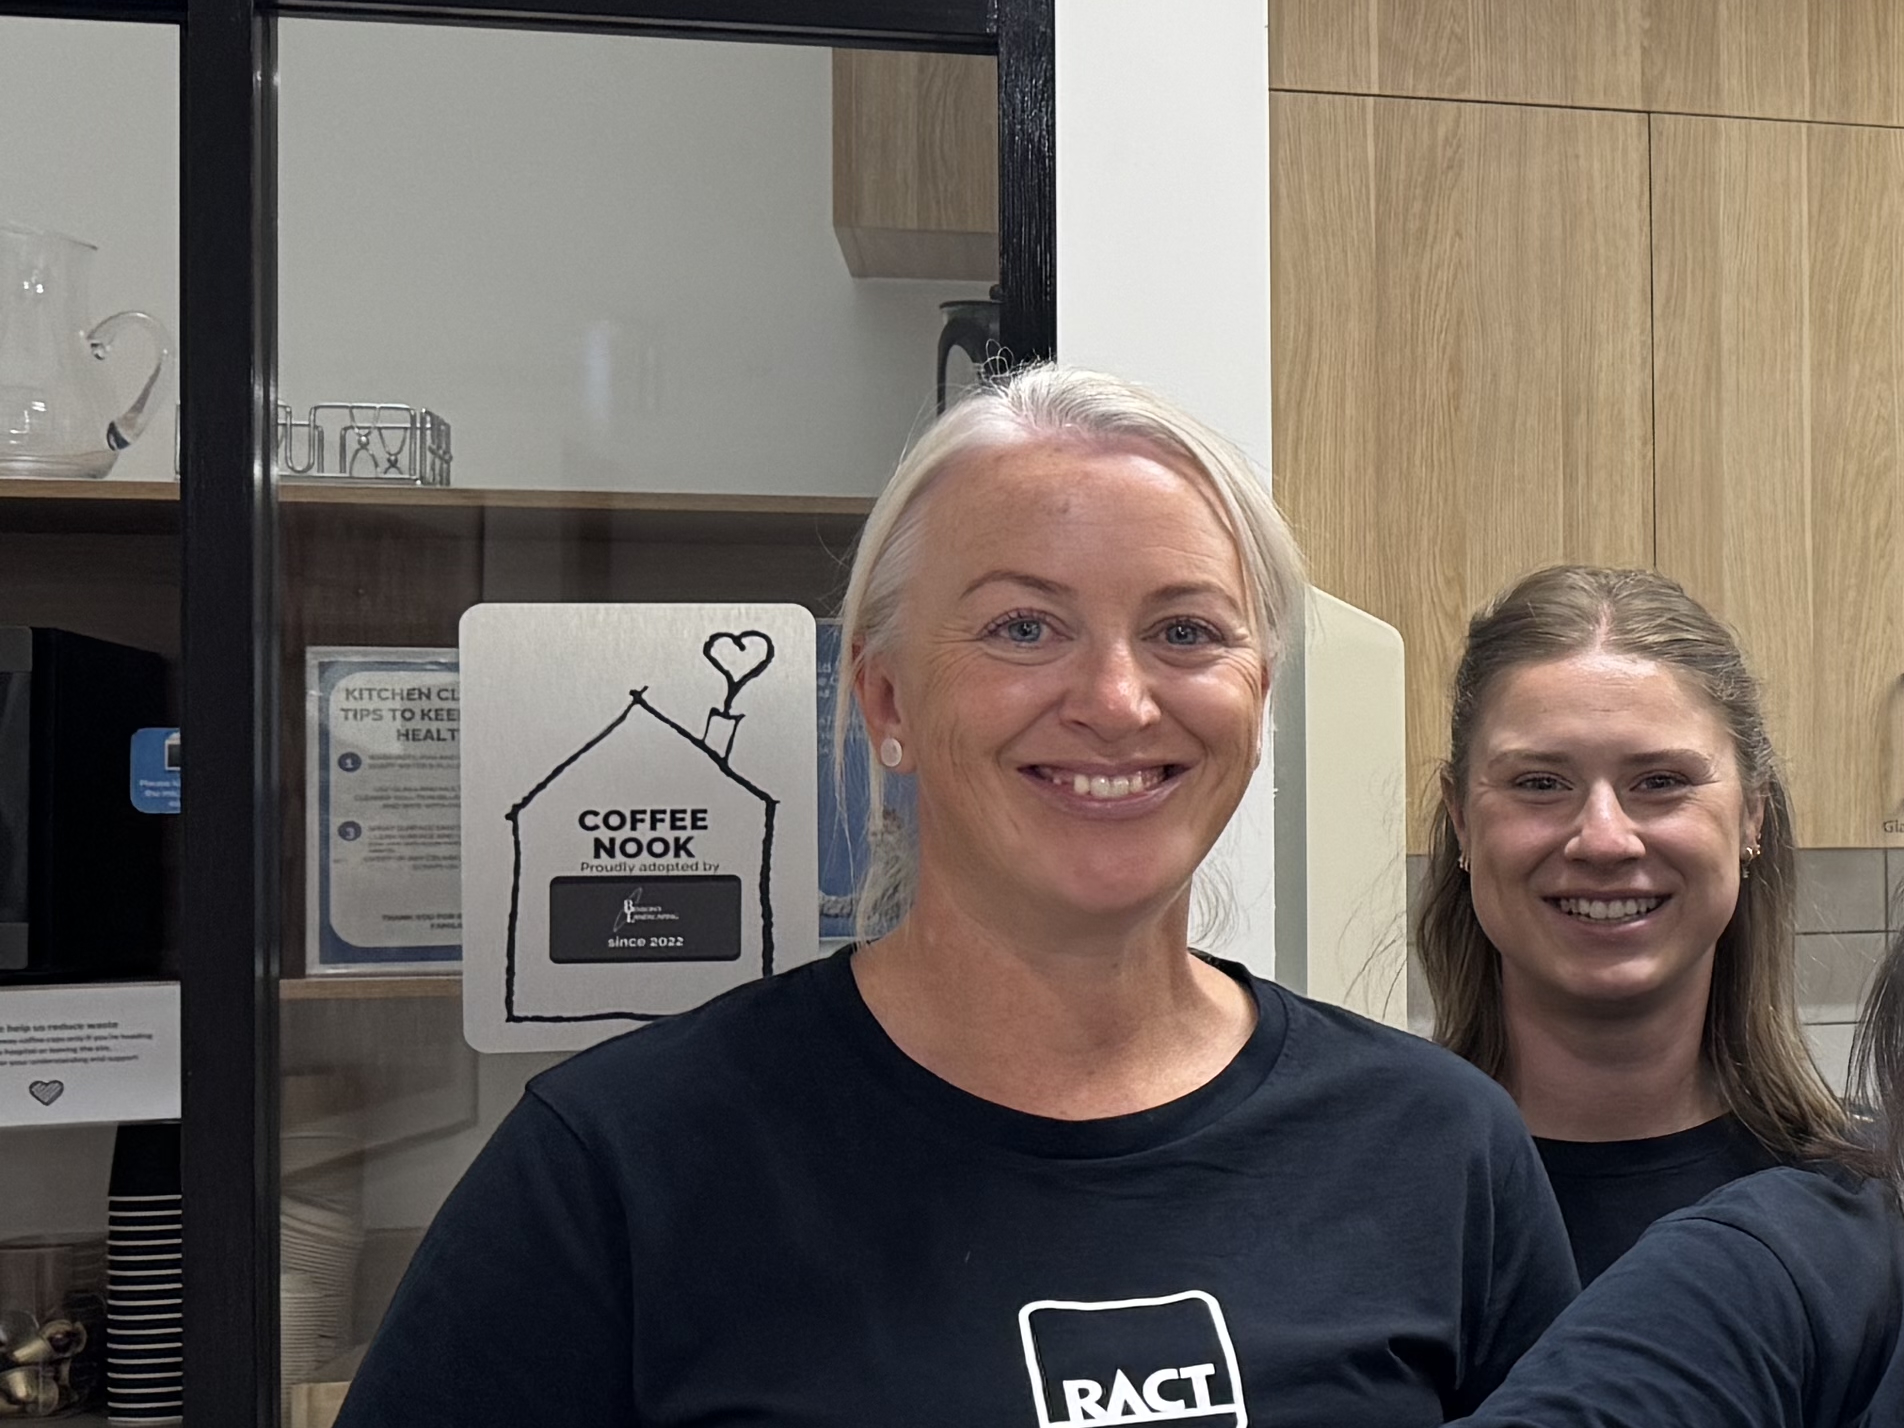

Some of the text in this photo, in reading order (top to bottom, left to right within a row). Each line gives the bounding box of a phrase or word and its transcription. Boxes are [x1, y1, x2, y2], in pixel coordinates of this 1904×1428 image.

[345, 688, 431, 703] KITCHEN
[340, 708, 459, 722] TIPS TO KEE
[578, 808, 709, 832] COFFEE
[593, 836, 696, 859] NOOK
[580, 861, 720, 875] Proudly adopted by
[608, 936, 684, 948] since 2022
[1062, 1363, 1216, 1422] RACT
